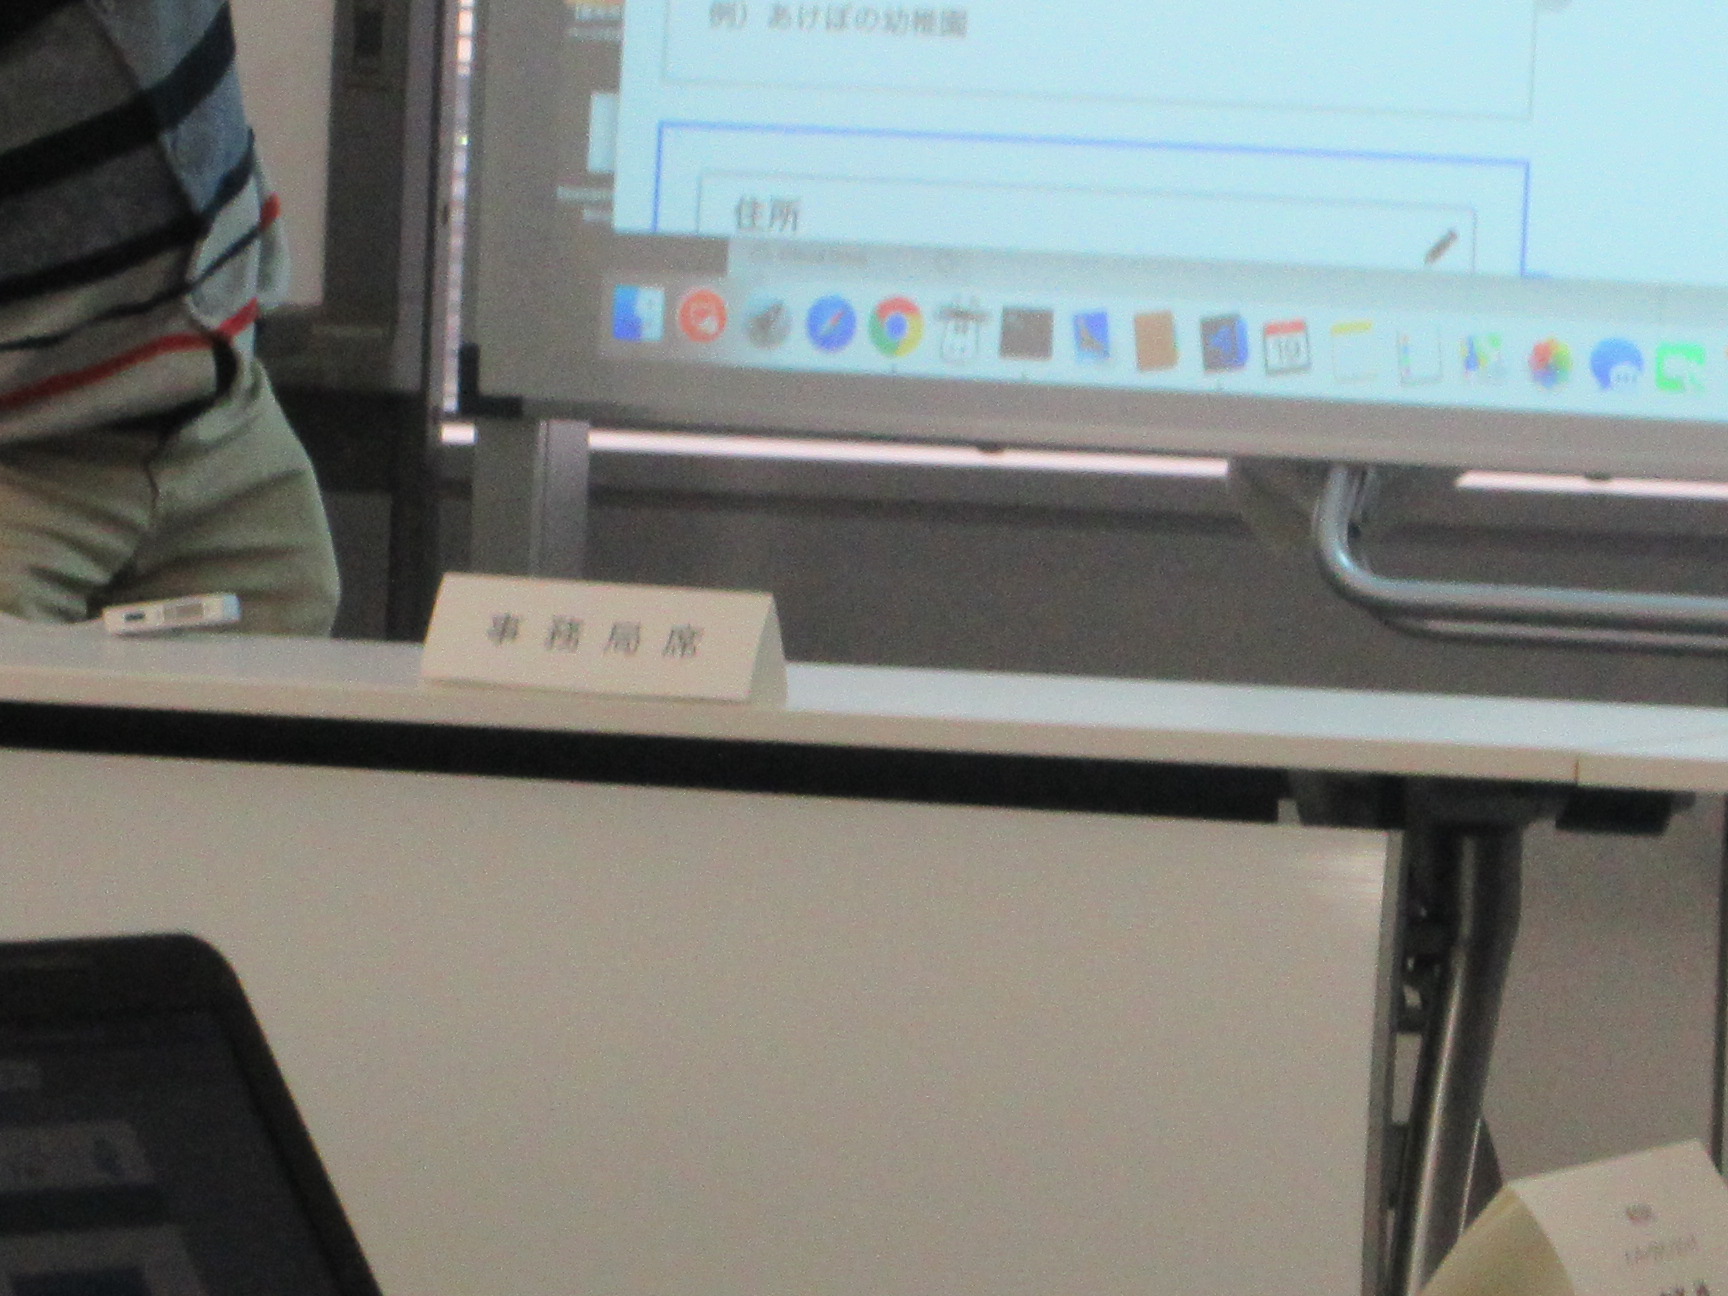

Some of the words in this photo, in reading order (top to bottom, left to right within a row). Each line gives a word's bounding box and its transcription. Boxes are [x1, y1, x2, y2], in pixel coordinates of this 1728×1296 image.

[765, 0, 971, 42] あけぼの幼稚園
[733, 194, 803, 234] 住所
[485, 611, 706, 660] 事務局席
